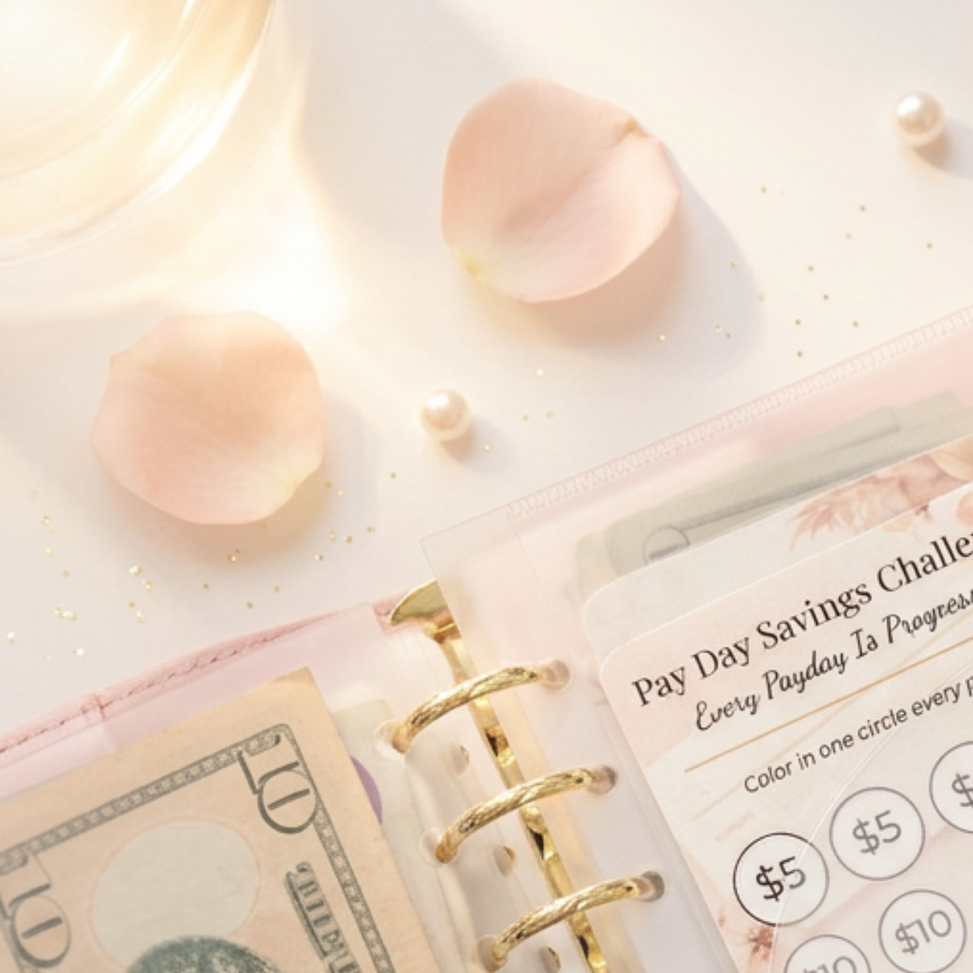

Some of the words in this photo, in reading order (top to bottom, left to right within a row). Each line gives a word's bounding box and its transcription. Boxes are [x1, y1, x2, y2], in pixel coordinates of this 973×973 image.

[631, 666, 686, 707] Pay
[691, 637, 749, 680] Day
[756, 583, 872, 650] Savings
[696, 694, 761, 732] Every
[762, 650, 849, 700] Payday
[744, 761, 792, 793] Color
[796, 752, 816, 770] in
[819, 734, 854, 759] one
[857, 708, 908, 741] circle
[911, 682, 961, 717] every
[756, 856, 807, 902] $5
[852, 810, 902, 855] $5
[895, 910, 952, 955] $10
